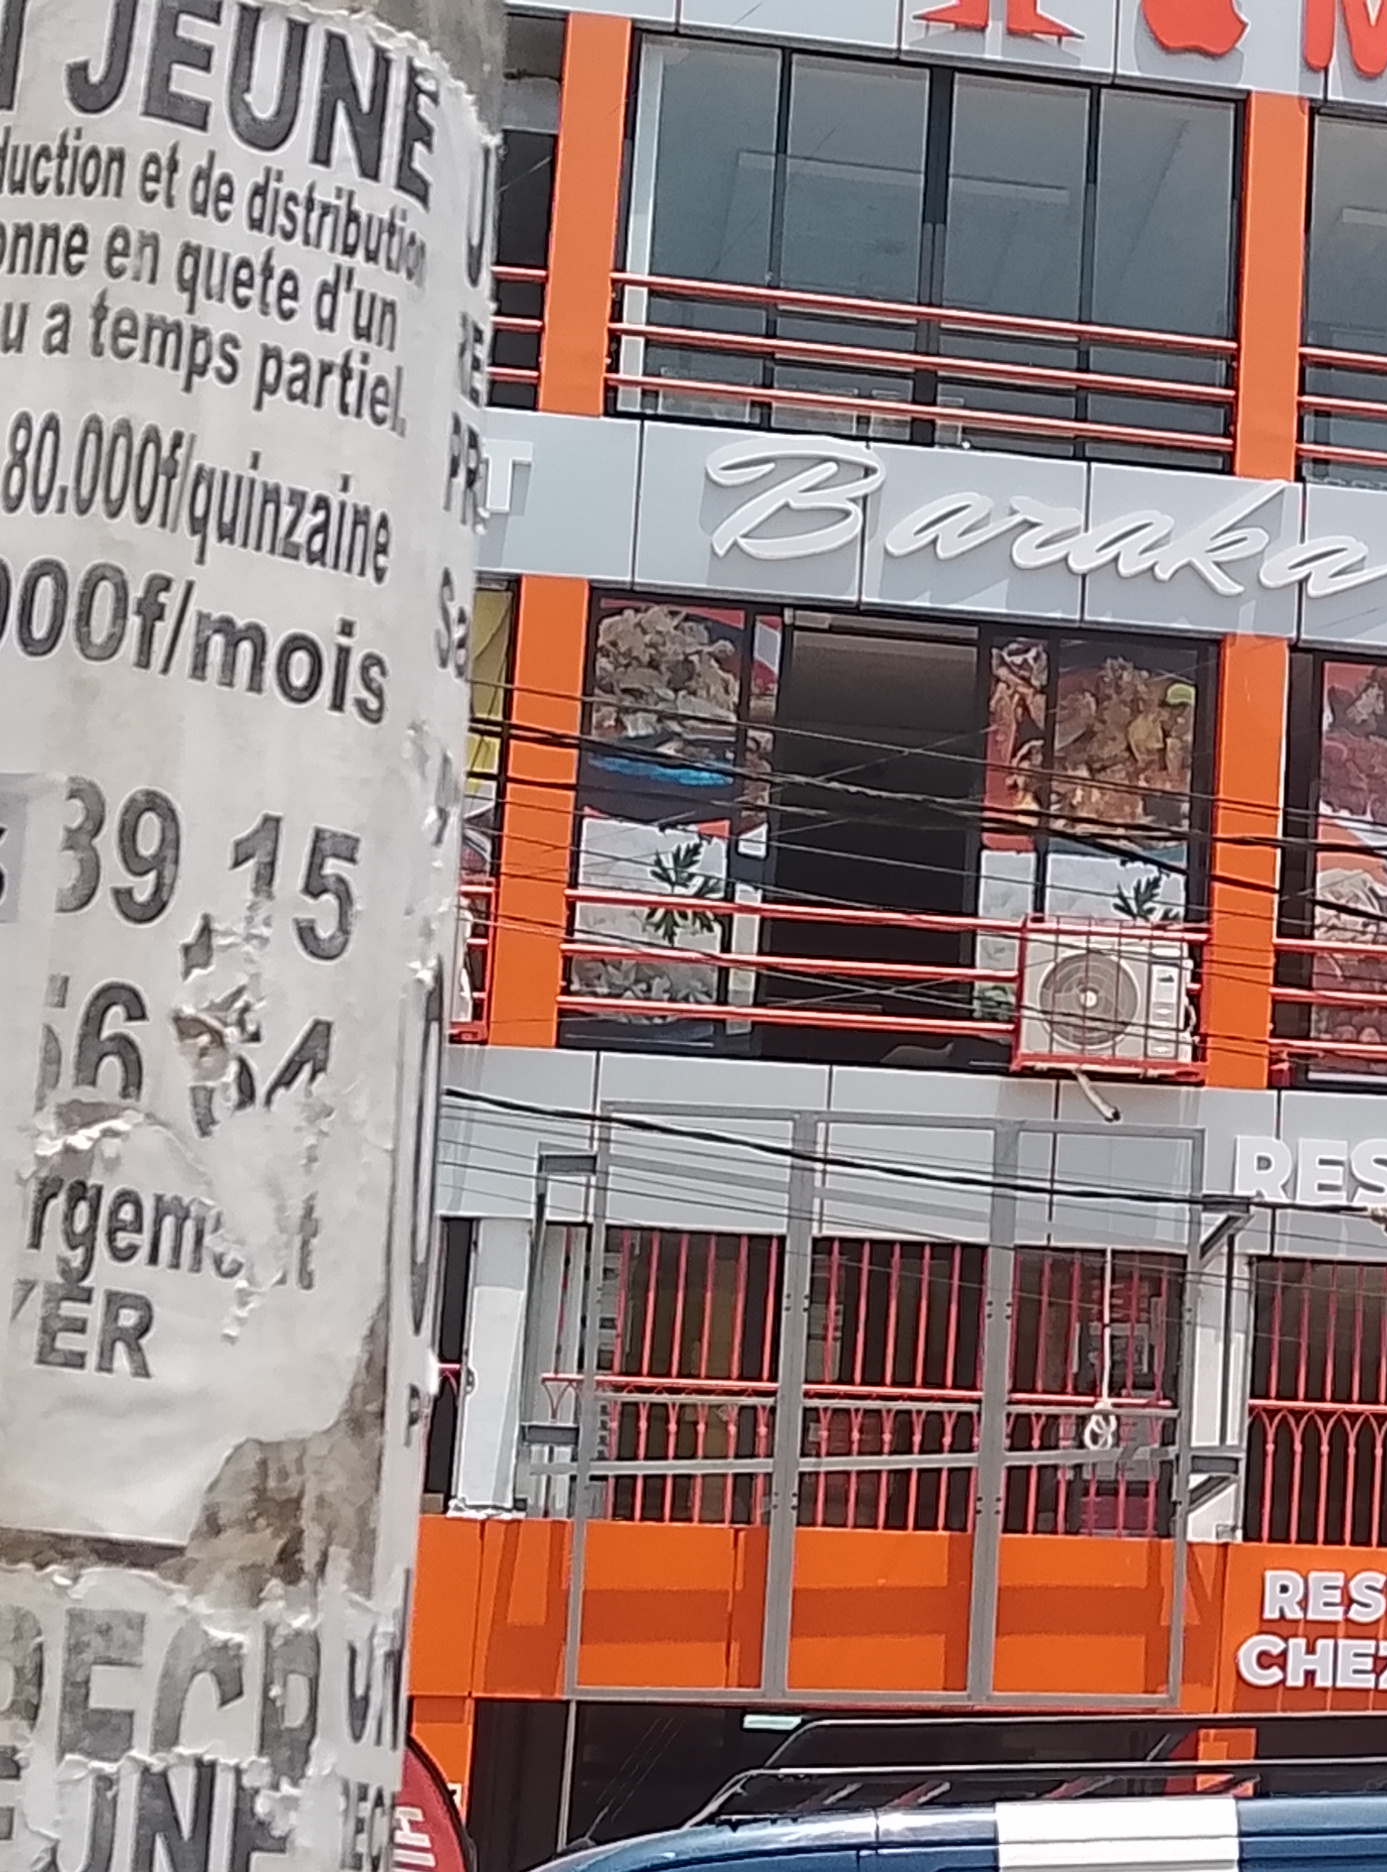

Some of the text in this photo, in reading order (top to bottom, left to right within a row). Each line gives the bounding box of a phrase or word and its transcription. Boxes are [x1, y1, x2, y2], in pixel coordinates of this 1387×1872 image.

[65, 0, 441, 212] JEUNE
[139, 140, 181, 209] et
[189, 149, 234, 223] de
[42, 302, 71, 355] a
[89, 288, 240, 393] temps
[253, 343, 407, 438] partiel.
[104, 224, 161, 286] en
[175, 240, 300, 322] quete
[315, 263, 397, 352] d'un
[2, 410, 391, 586] 80.000f/quinzaine
[0, 556, 388, 726] 00f/mois
